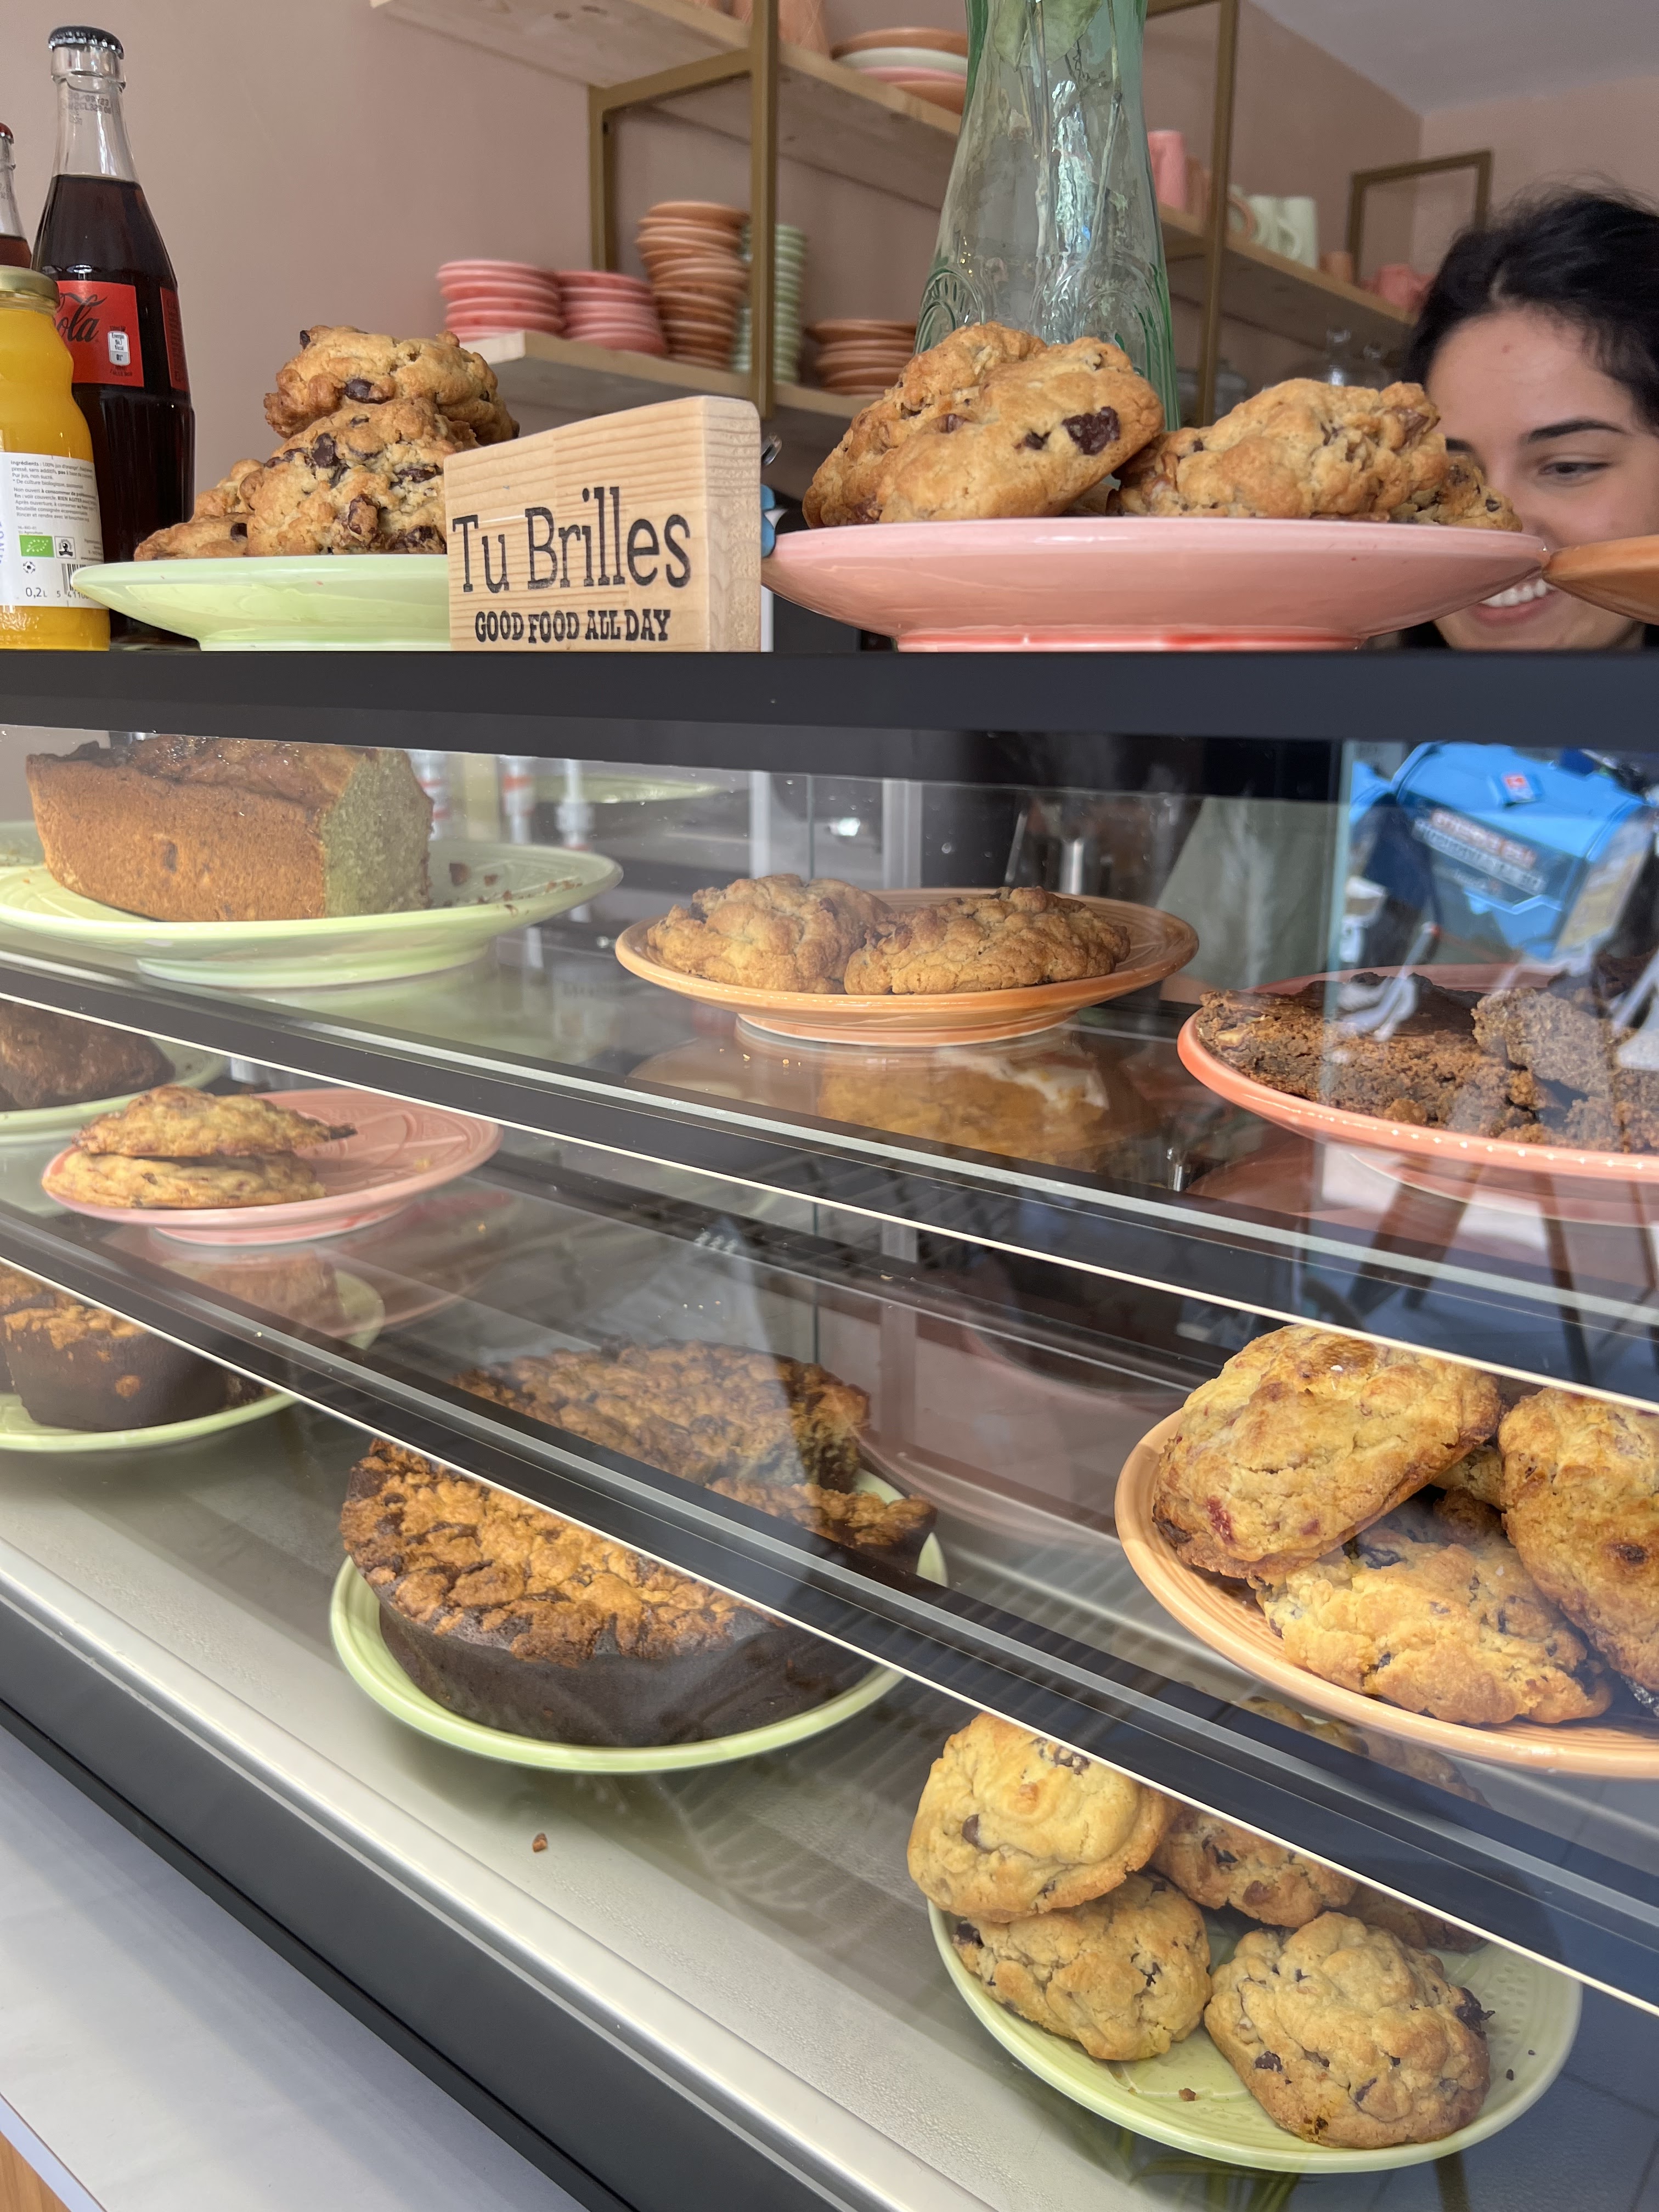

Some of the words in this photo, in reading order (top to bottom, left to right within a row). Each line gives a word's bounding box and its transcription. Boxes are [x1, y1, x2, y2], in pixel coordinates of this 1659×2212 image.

[453, 514, 510, 593] Tu
[525, 487, 691, 590] Brilles
[475, 610, 525, 642] GOOD
[528, 611, 579, 644] FOOD
[585, 610, 620, 641] ALL
[625, 609, 670, 641] DAY
